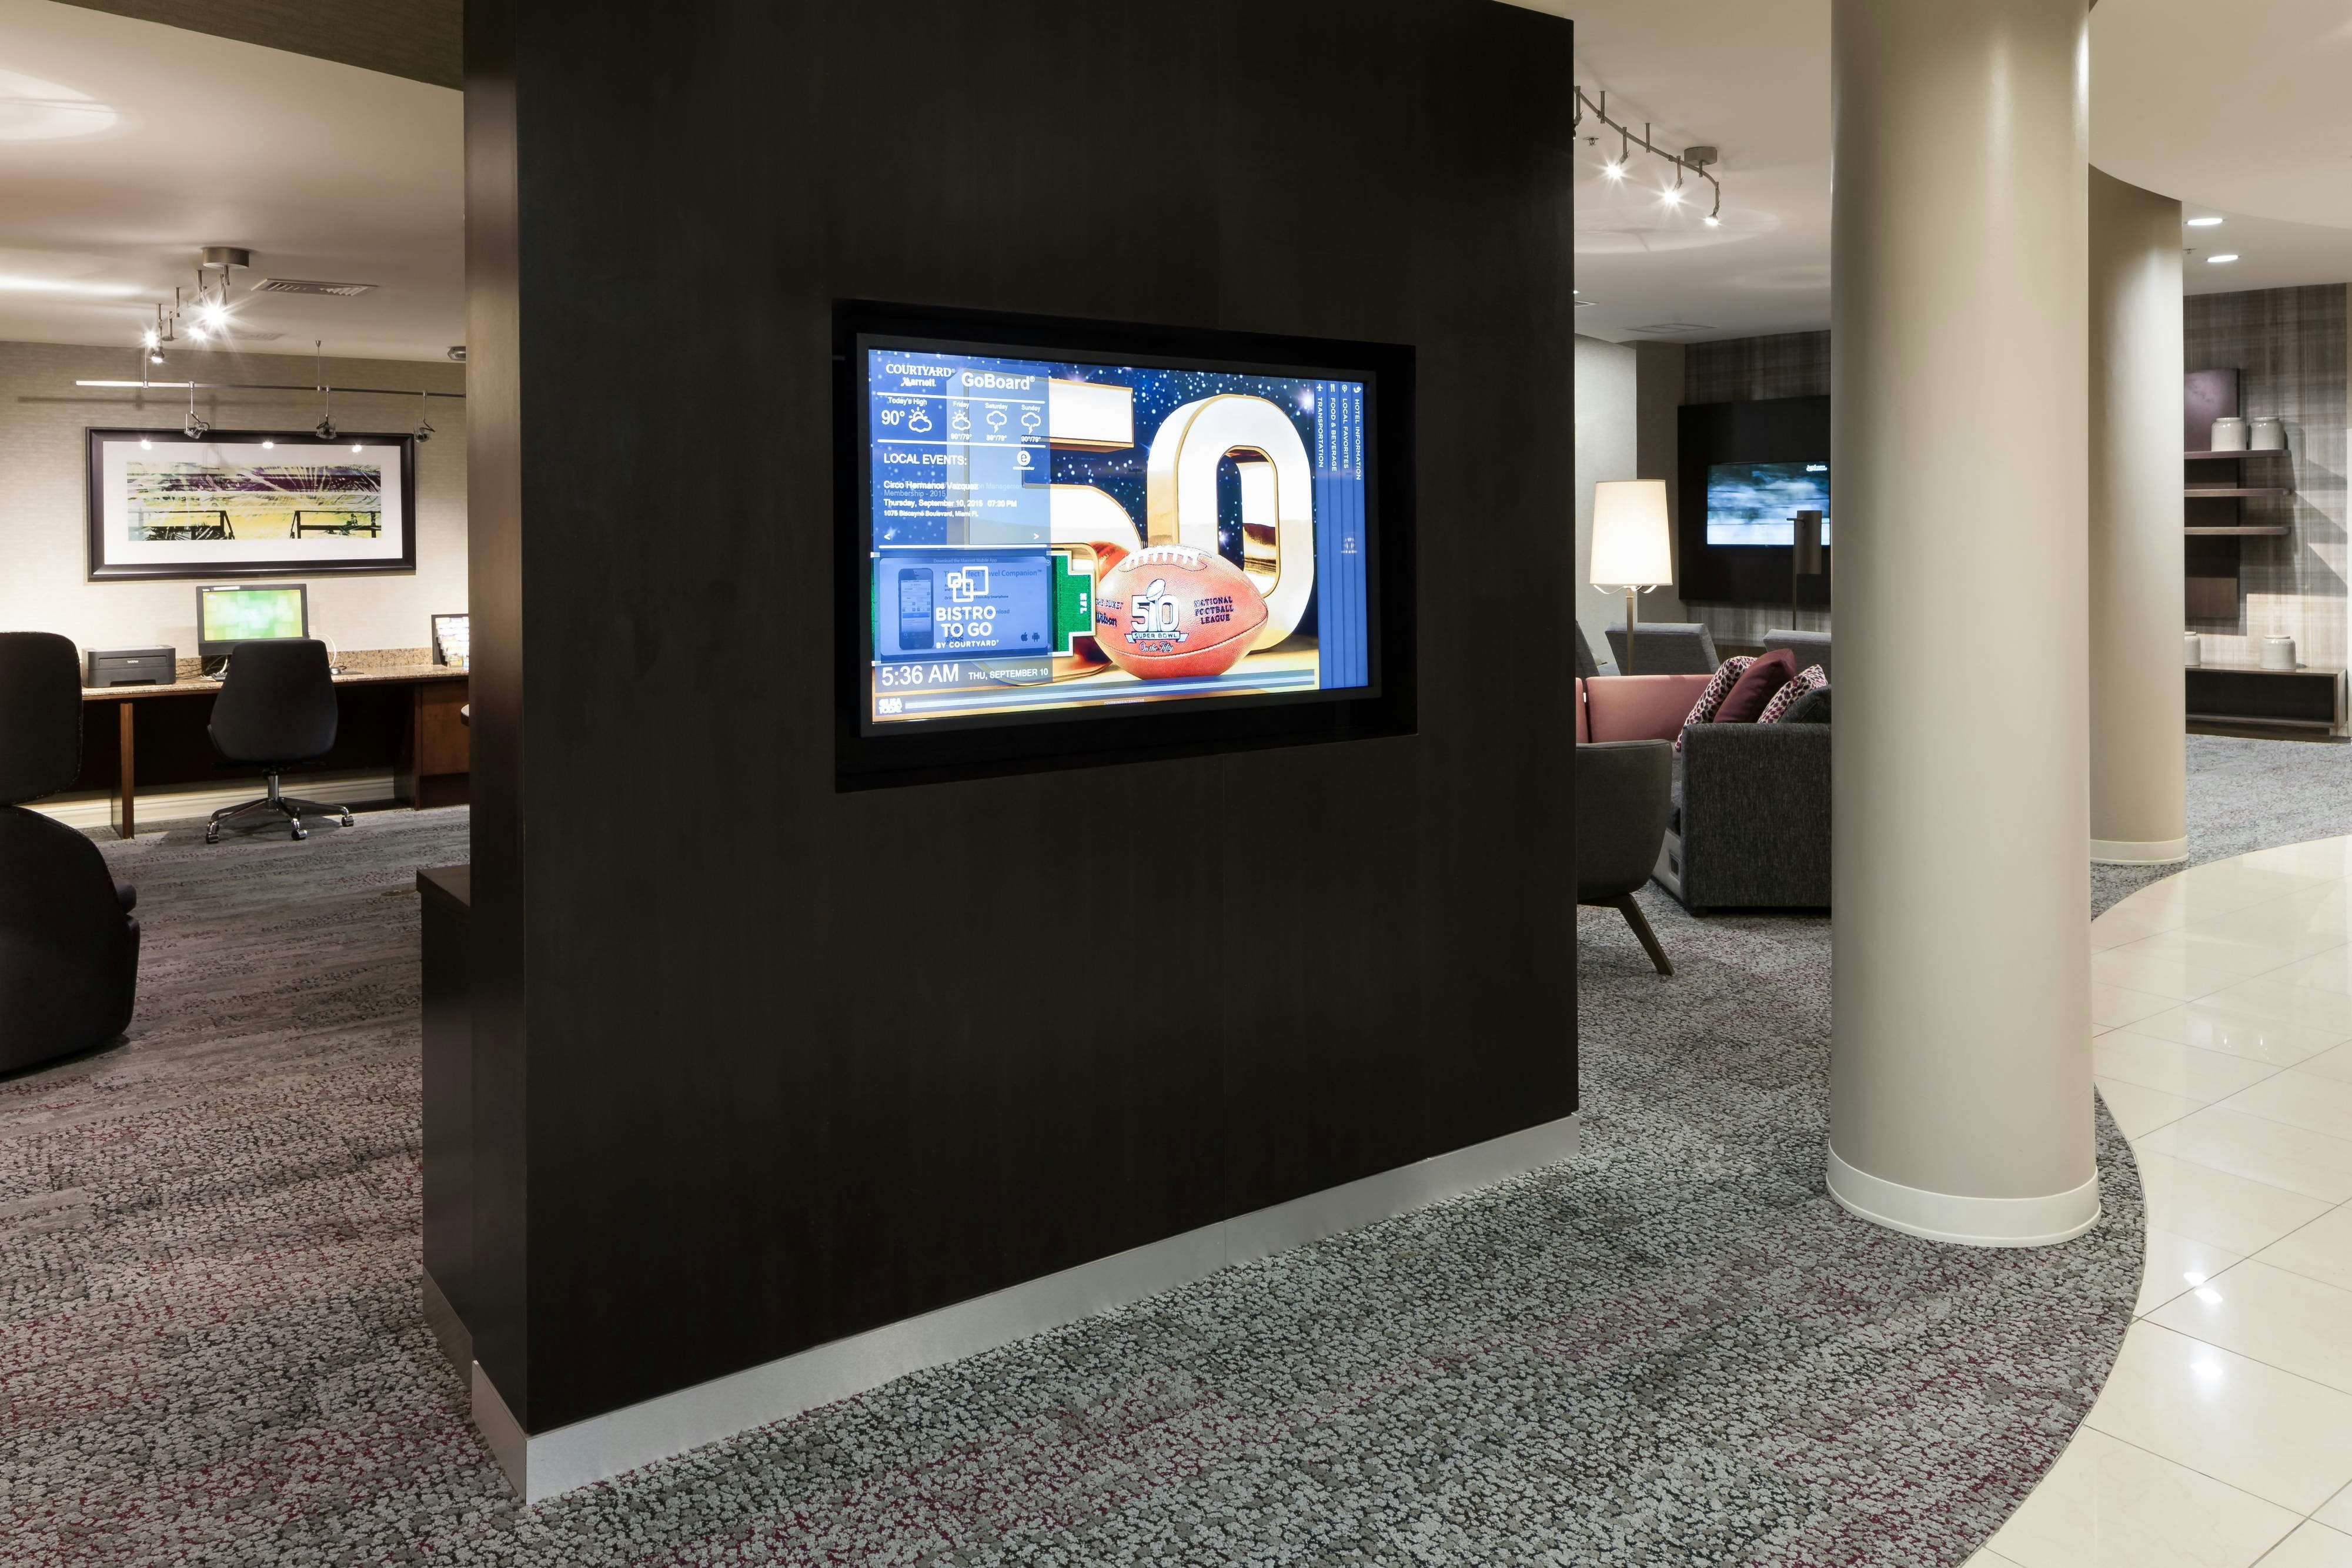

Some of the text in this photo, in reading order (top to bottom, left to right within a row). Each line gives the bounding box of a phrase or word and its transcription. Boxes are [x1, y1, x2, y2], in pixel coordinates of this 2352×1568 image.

[888, 396, 913, 406] Today's
[953, 401, 970, 409] Friday
[985, 403, 1008, 411] Saturday
[881, 410, 906, 426] 90°
[883, 453, 967, 466] LOCAL EVENTS:
[947, 482, 979, 492] Vazquez
[883, 499, 917, 508] Thursday,
[918, 500, 954, 509] September
[956, 500, 966, 508] 10,
[1194, 596, 1233, 608] NATIONAL
[936, 606, 996, 621] BISTRO
[1131, 594, 1180, 632] 50
[1194, 605, 1234, 616] FOOTBALL
[1200, 614, 1231, 625] LEAGUE
[941, 621, 992, 637] TO GO
[1148, 643, 1158, 651] the
[882, 663, 959, 686] 5:36 AM
[968, 672, 988, 680] THU,
[989, 669, 1038, 679] SEPTEMBER
